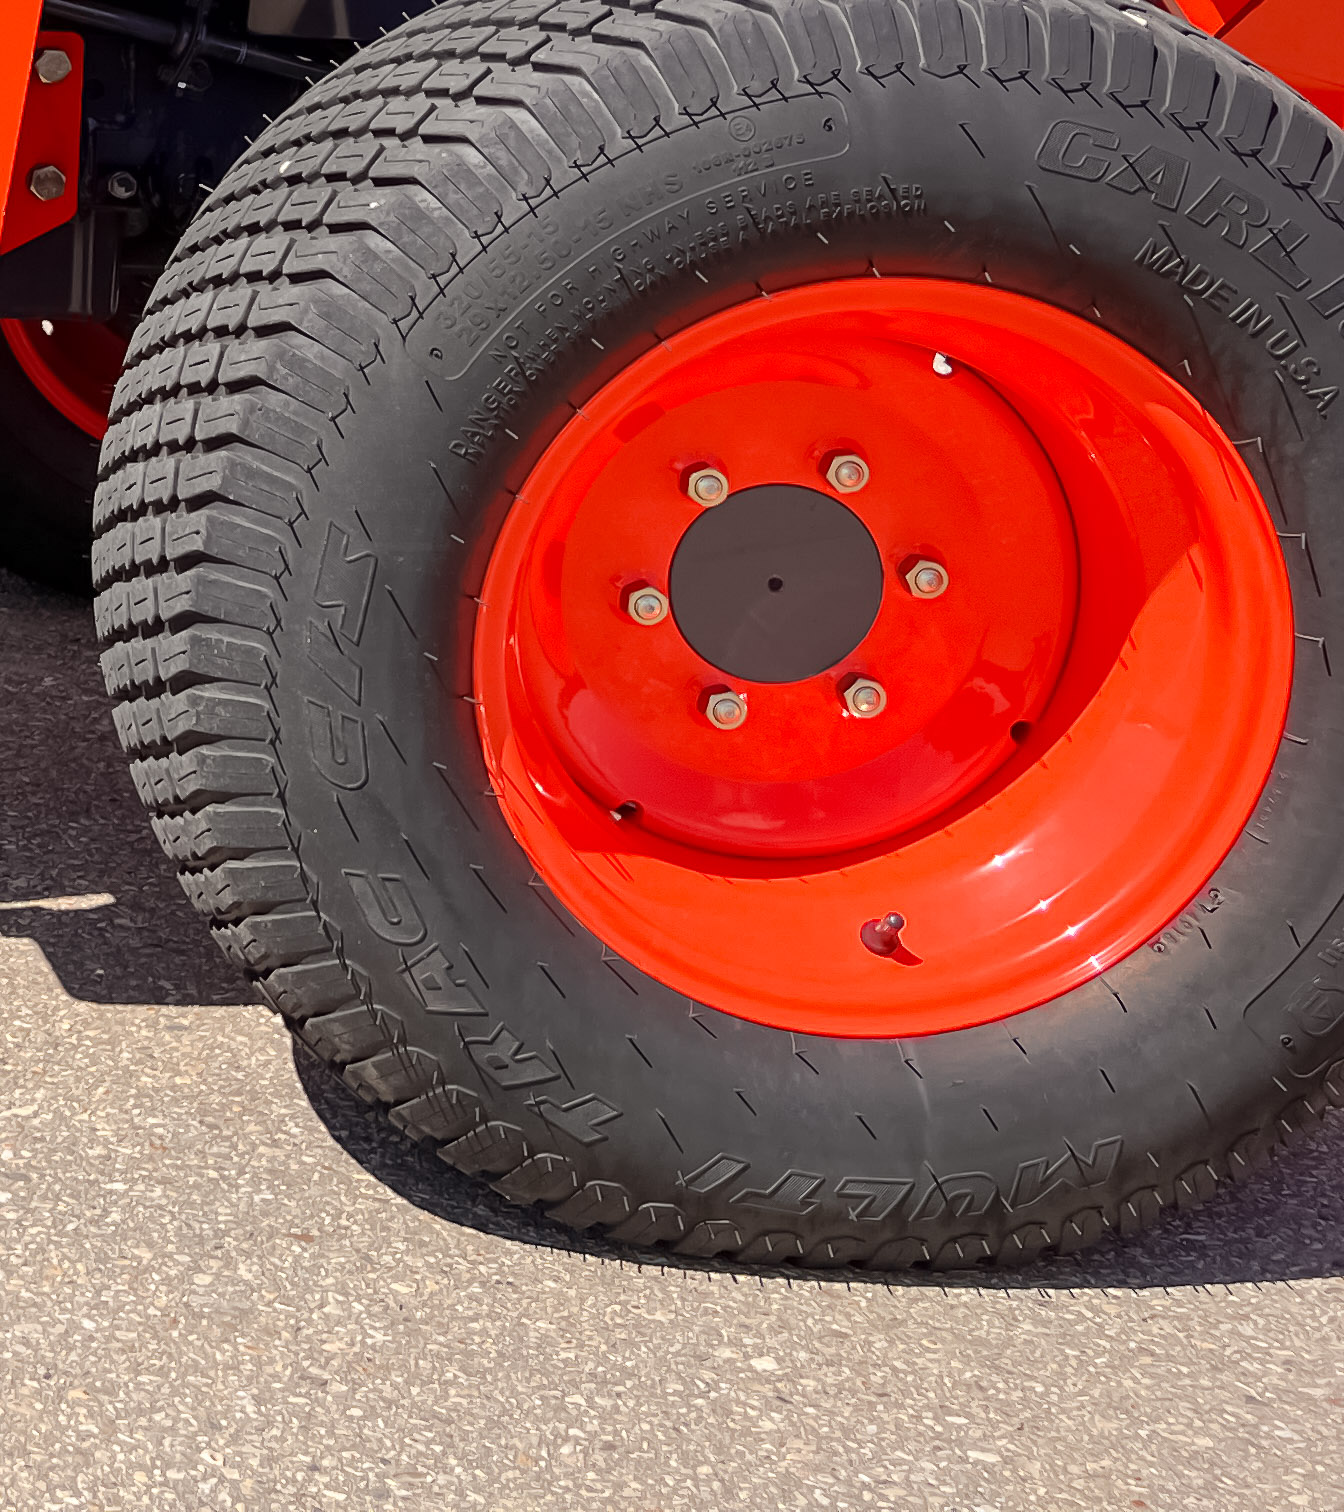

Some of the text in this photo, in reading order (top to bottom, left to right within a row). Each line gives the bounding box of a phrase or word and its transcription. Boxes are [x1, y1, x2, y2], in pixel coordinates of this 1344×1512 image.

[489, 320, 529, 363] NOT
[534, 278, 579, 318] FOR
[705, 169, 816, 214] SERVICE
[1035, 119, 1344, 336] CARLI
[1134, 237, 1239, 313] MADE
[1228, 297, 1274, 336] IN
[341, 868, 624, 1147] TRAC
[675, 1135, 1123, 1222] MULTI
